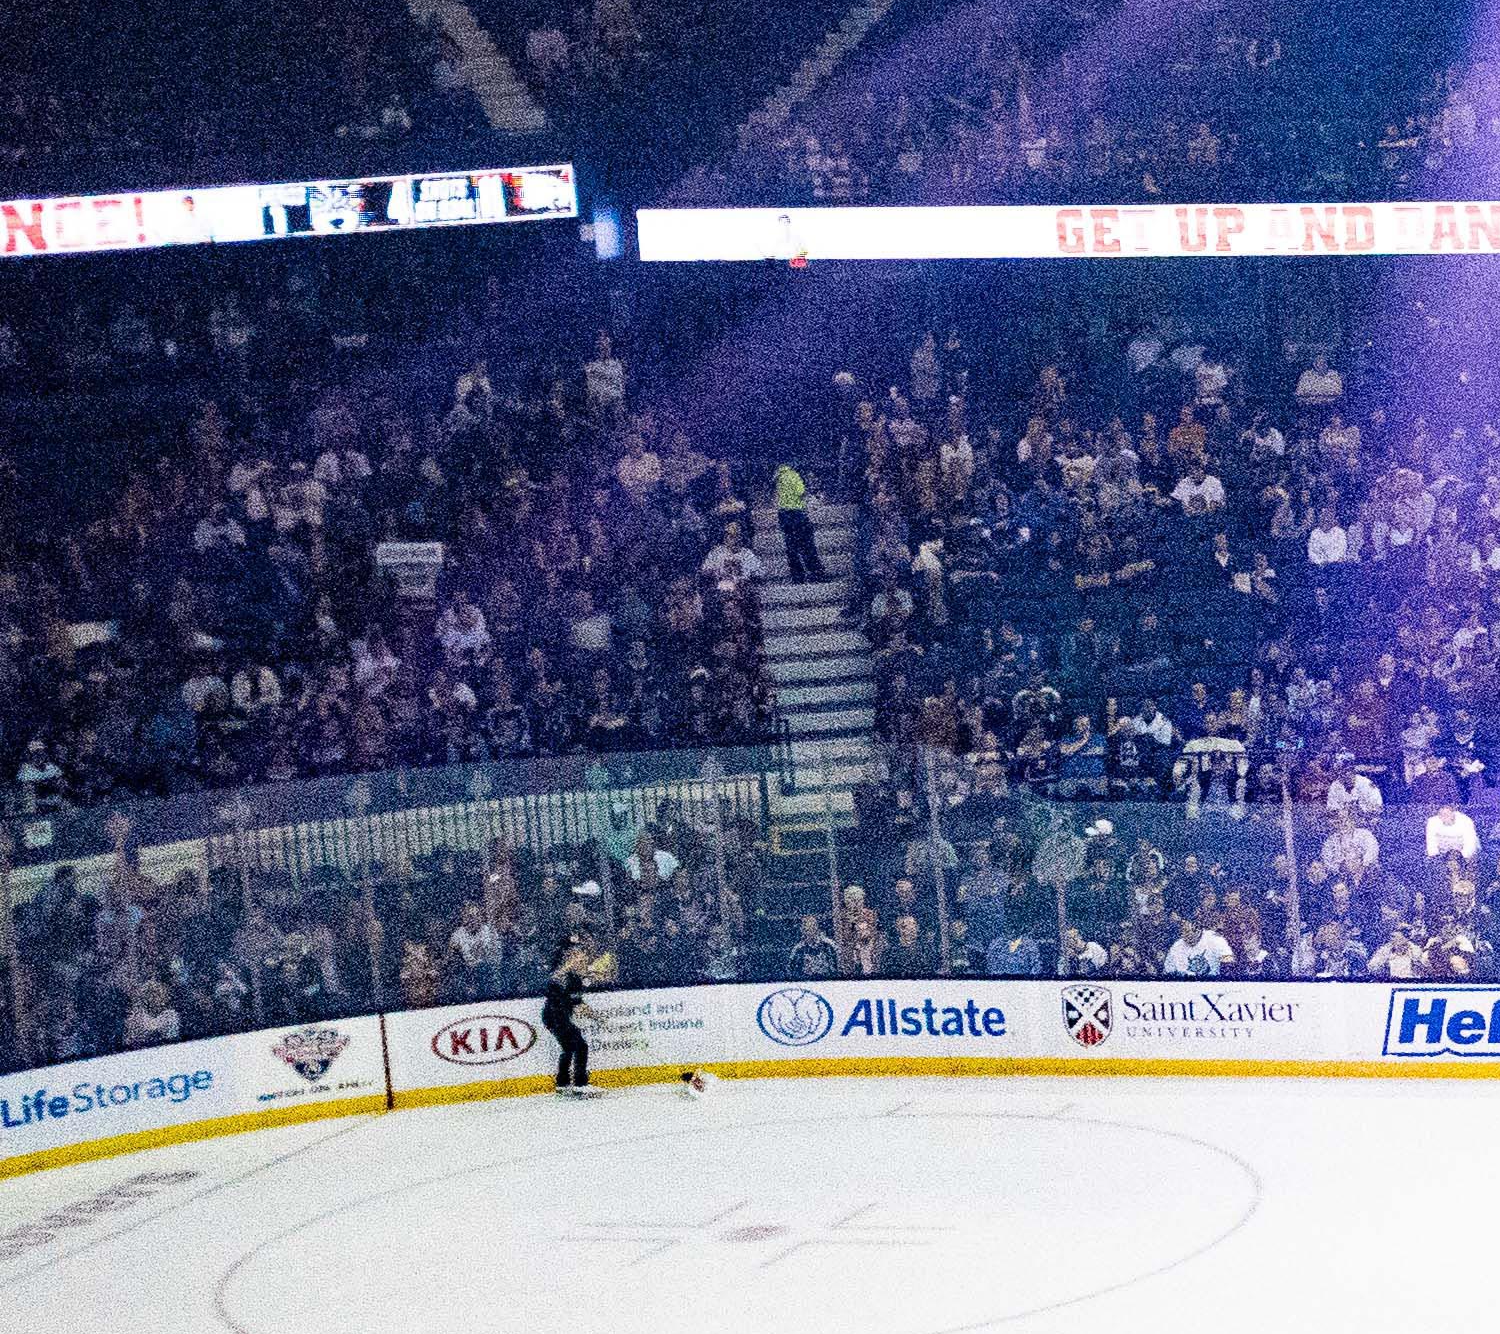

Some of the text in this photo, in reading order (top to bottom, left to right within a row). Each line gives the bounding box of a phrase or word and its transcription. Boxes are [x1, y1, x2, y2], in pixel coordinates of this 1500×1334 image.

[1174, 206, 1246, 253] UP
[841, 998, 1007, 1038] Allstate
[1122, 992, 1300, 1026] Saint Xavier
[450, 1025, 518, 1057] KIA
[1126, 1026, 1256, 1040] UNIVERSITY
[0, 1069, 213, 1129] LifeStorage
